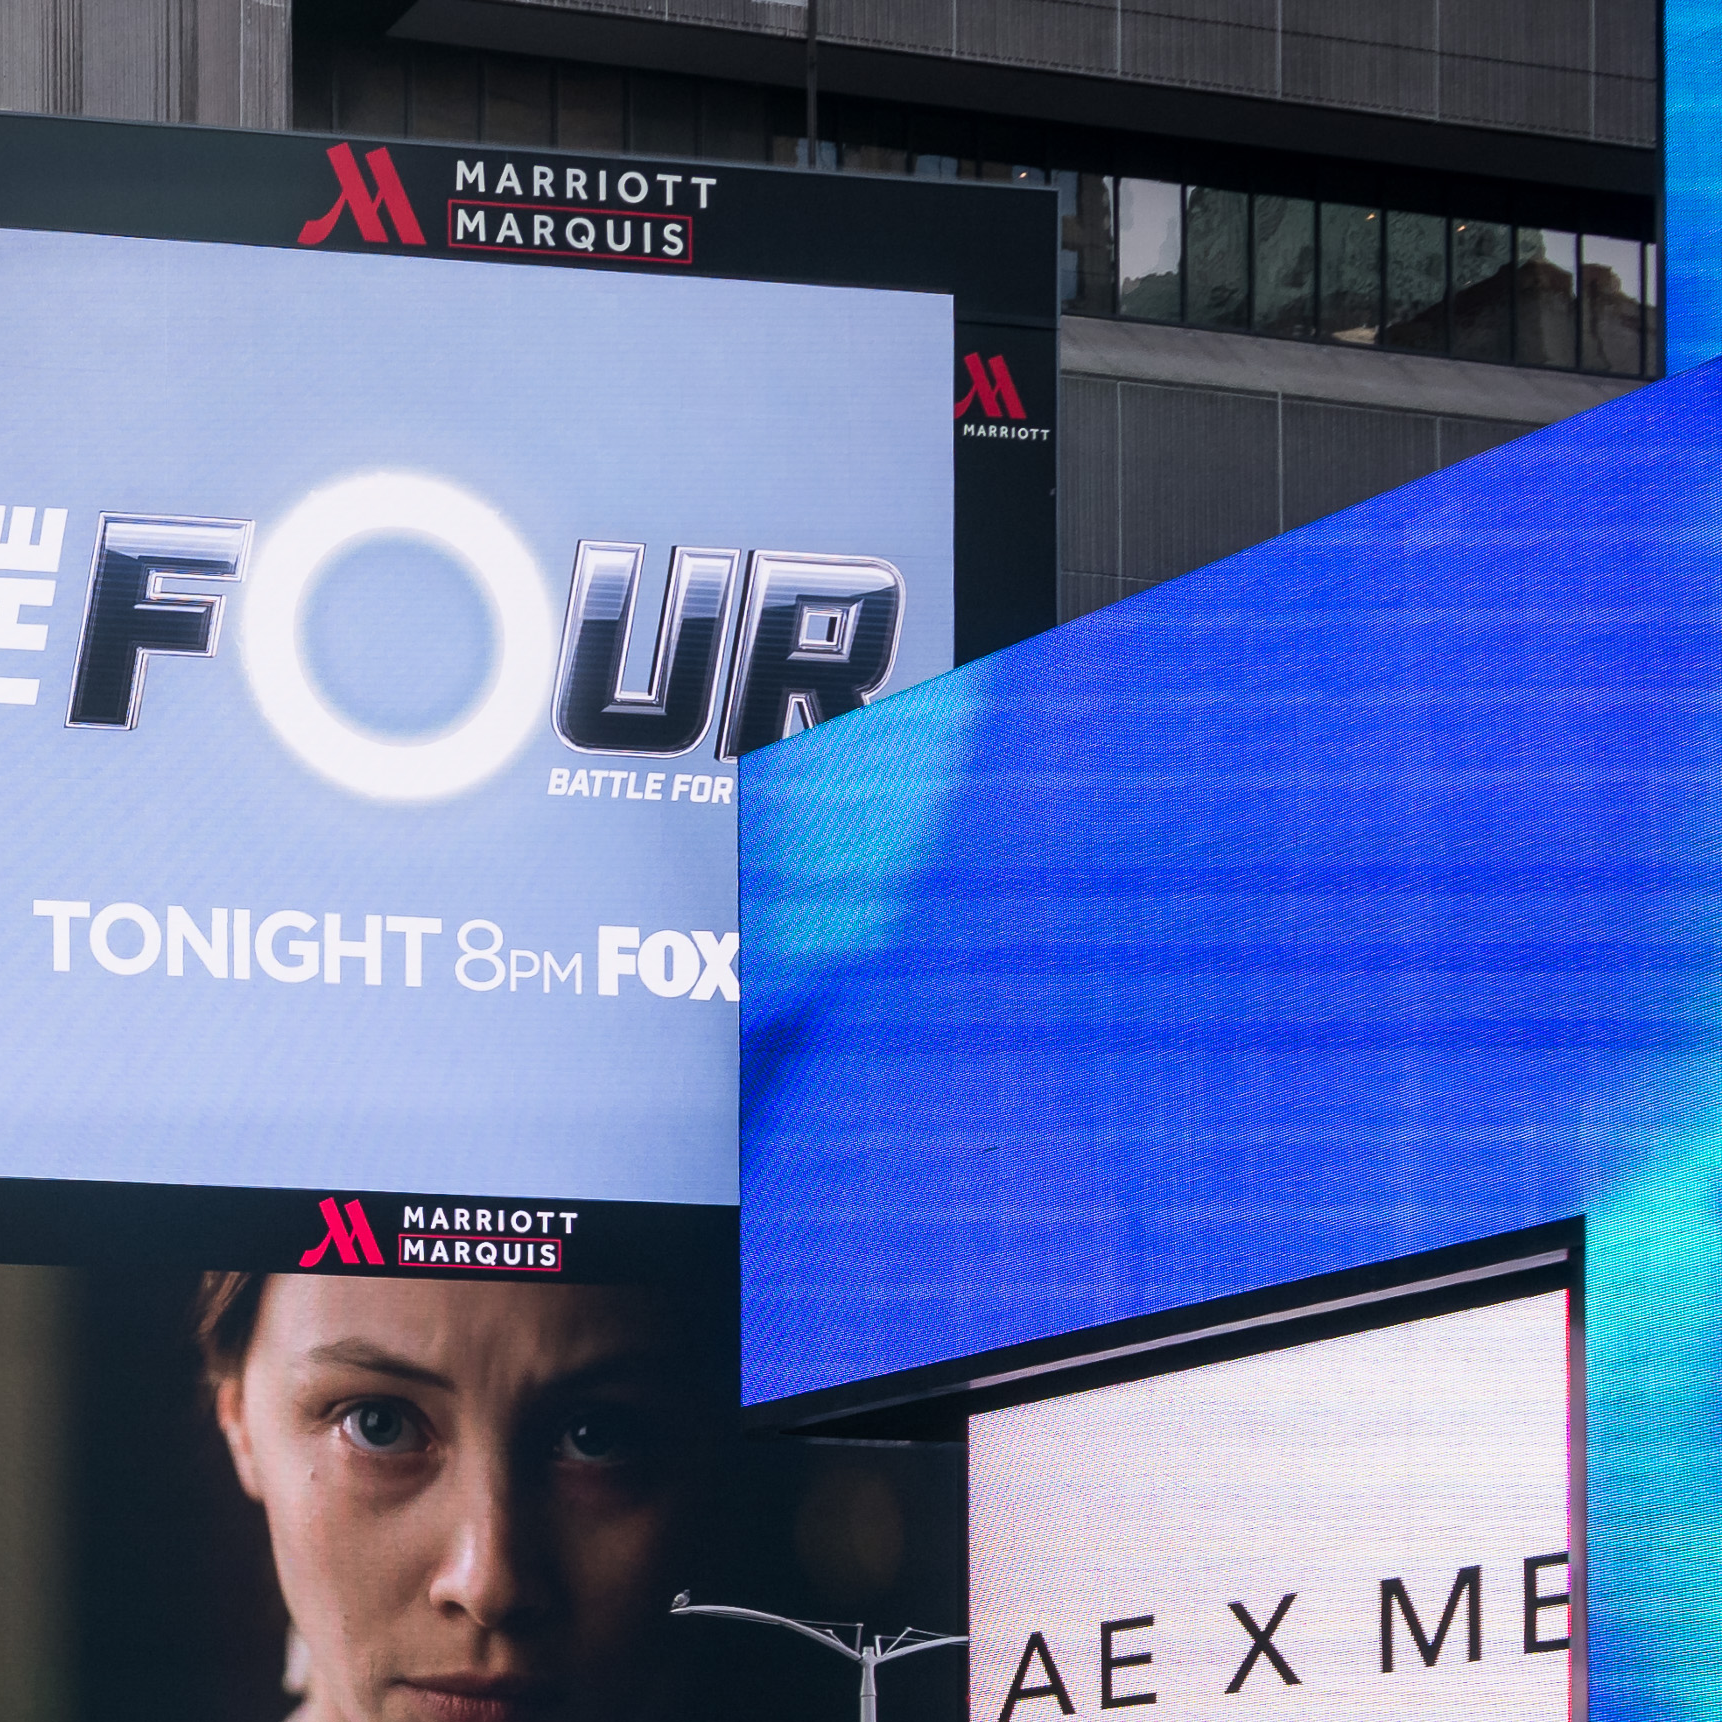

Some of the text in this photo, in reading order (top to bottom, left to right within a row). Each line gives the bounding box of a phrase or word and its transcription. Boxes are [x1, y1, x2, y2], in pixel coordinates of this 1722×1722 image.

[455, 158, 717, 212] MARRIOTT
[453, 207, 688, 259] MARQUIS
[962, 423, 1051, 441] MARRIOTT
[64, 470, 908, 800] FOUR
[547, 766, 733, 806] BATTLE FOR
[31, 898, 740, 1003] TONIGHT 8PM FOX
[402, 1205, 579, 1236] MARRIOTT
[402, 1237, 558, 1269] MARQUIS
[1223, 1592, 1302, 1696] X
